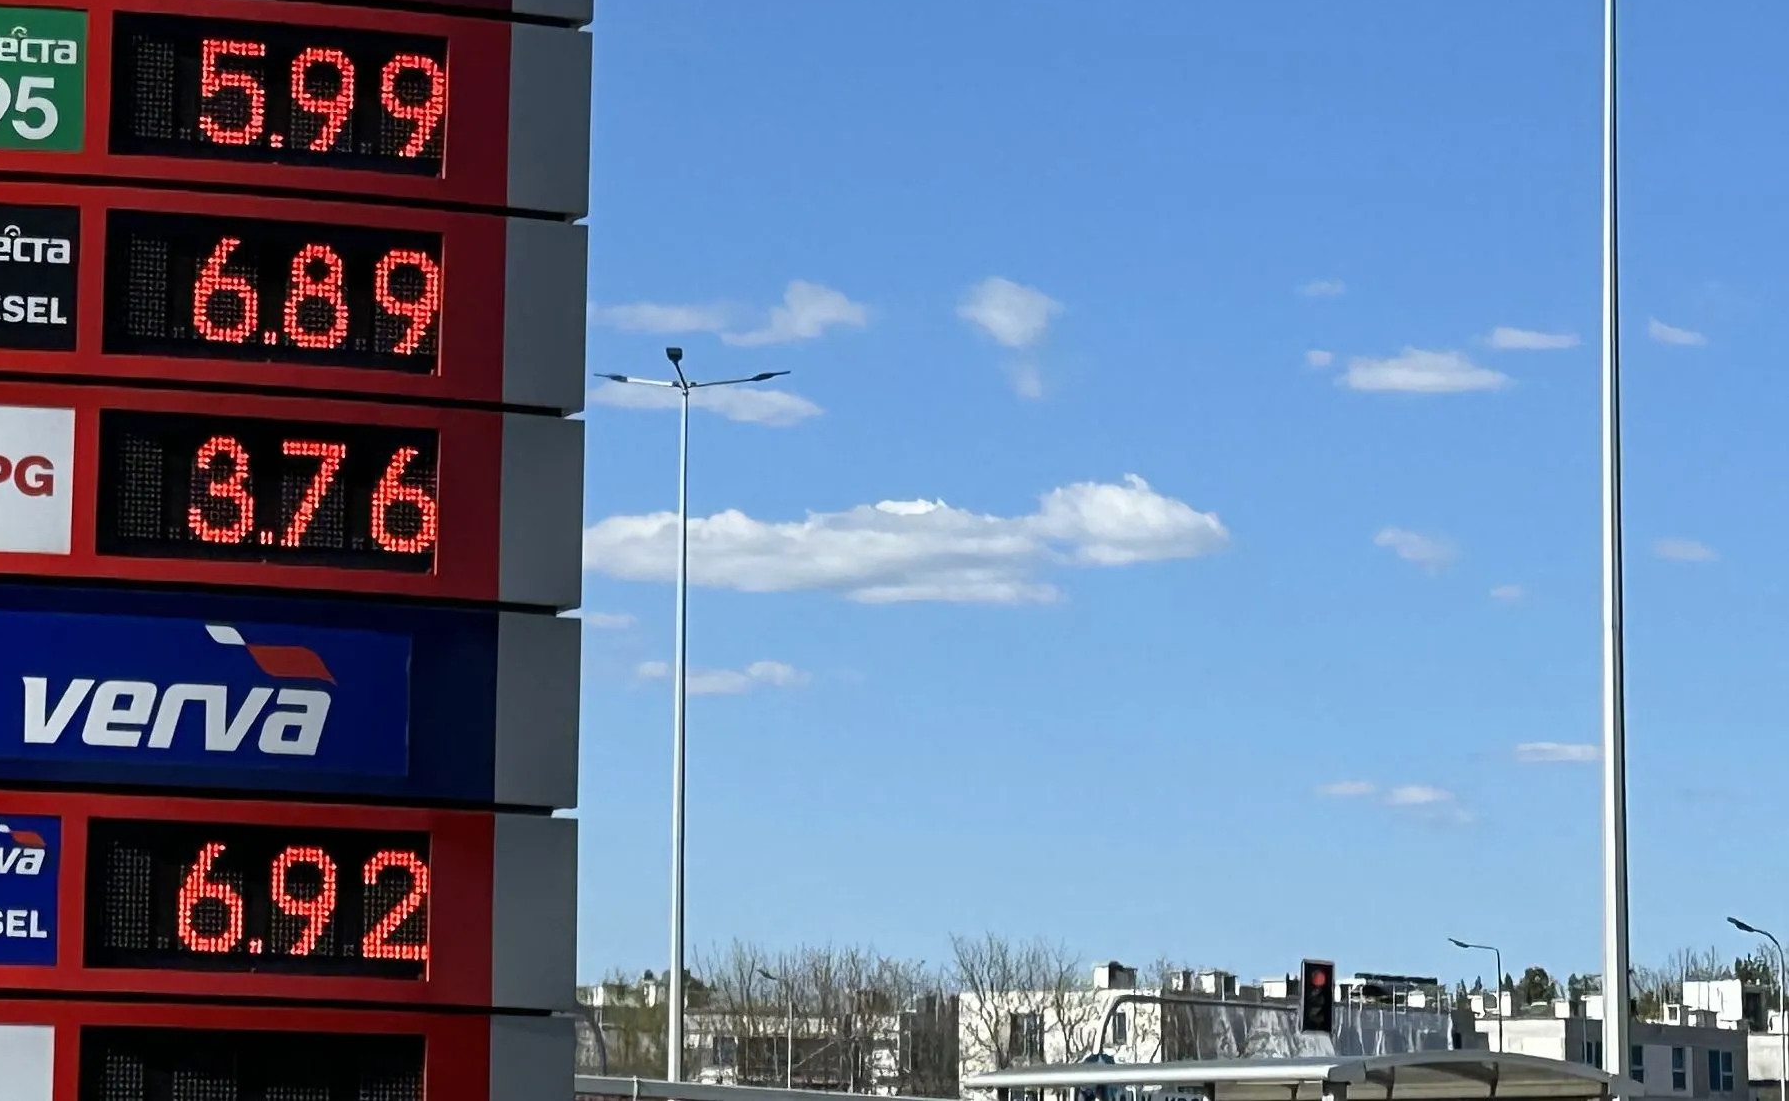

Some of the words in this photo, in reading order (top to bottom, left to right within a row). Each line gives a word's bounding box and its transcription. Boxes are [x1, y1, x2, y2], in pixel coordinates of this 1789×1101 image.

[198, 37, 447, 158] 5.99
[193, 236, 440, 355] 6.89
[187, 435, 437, 554] 3.76
[22, 676, 332, 756] verva
[177, 841, 430, 960] 6.92
